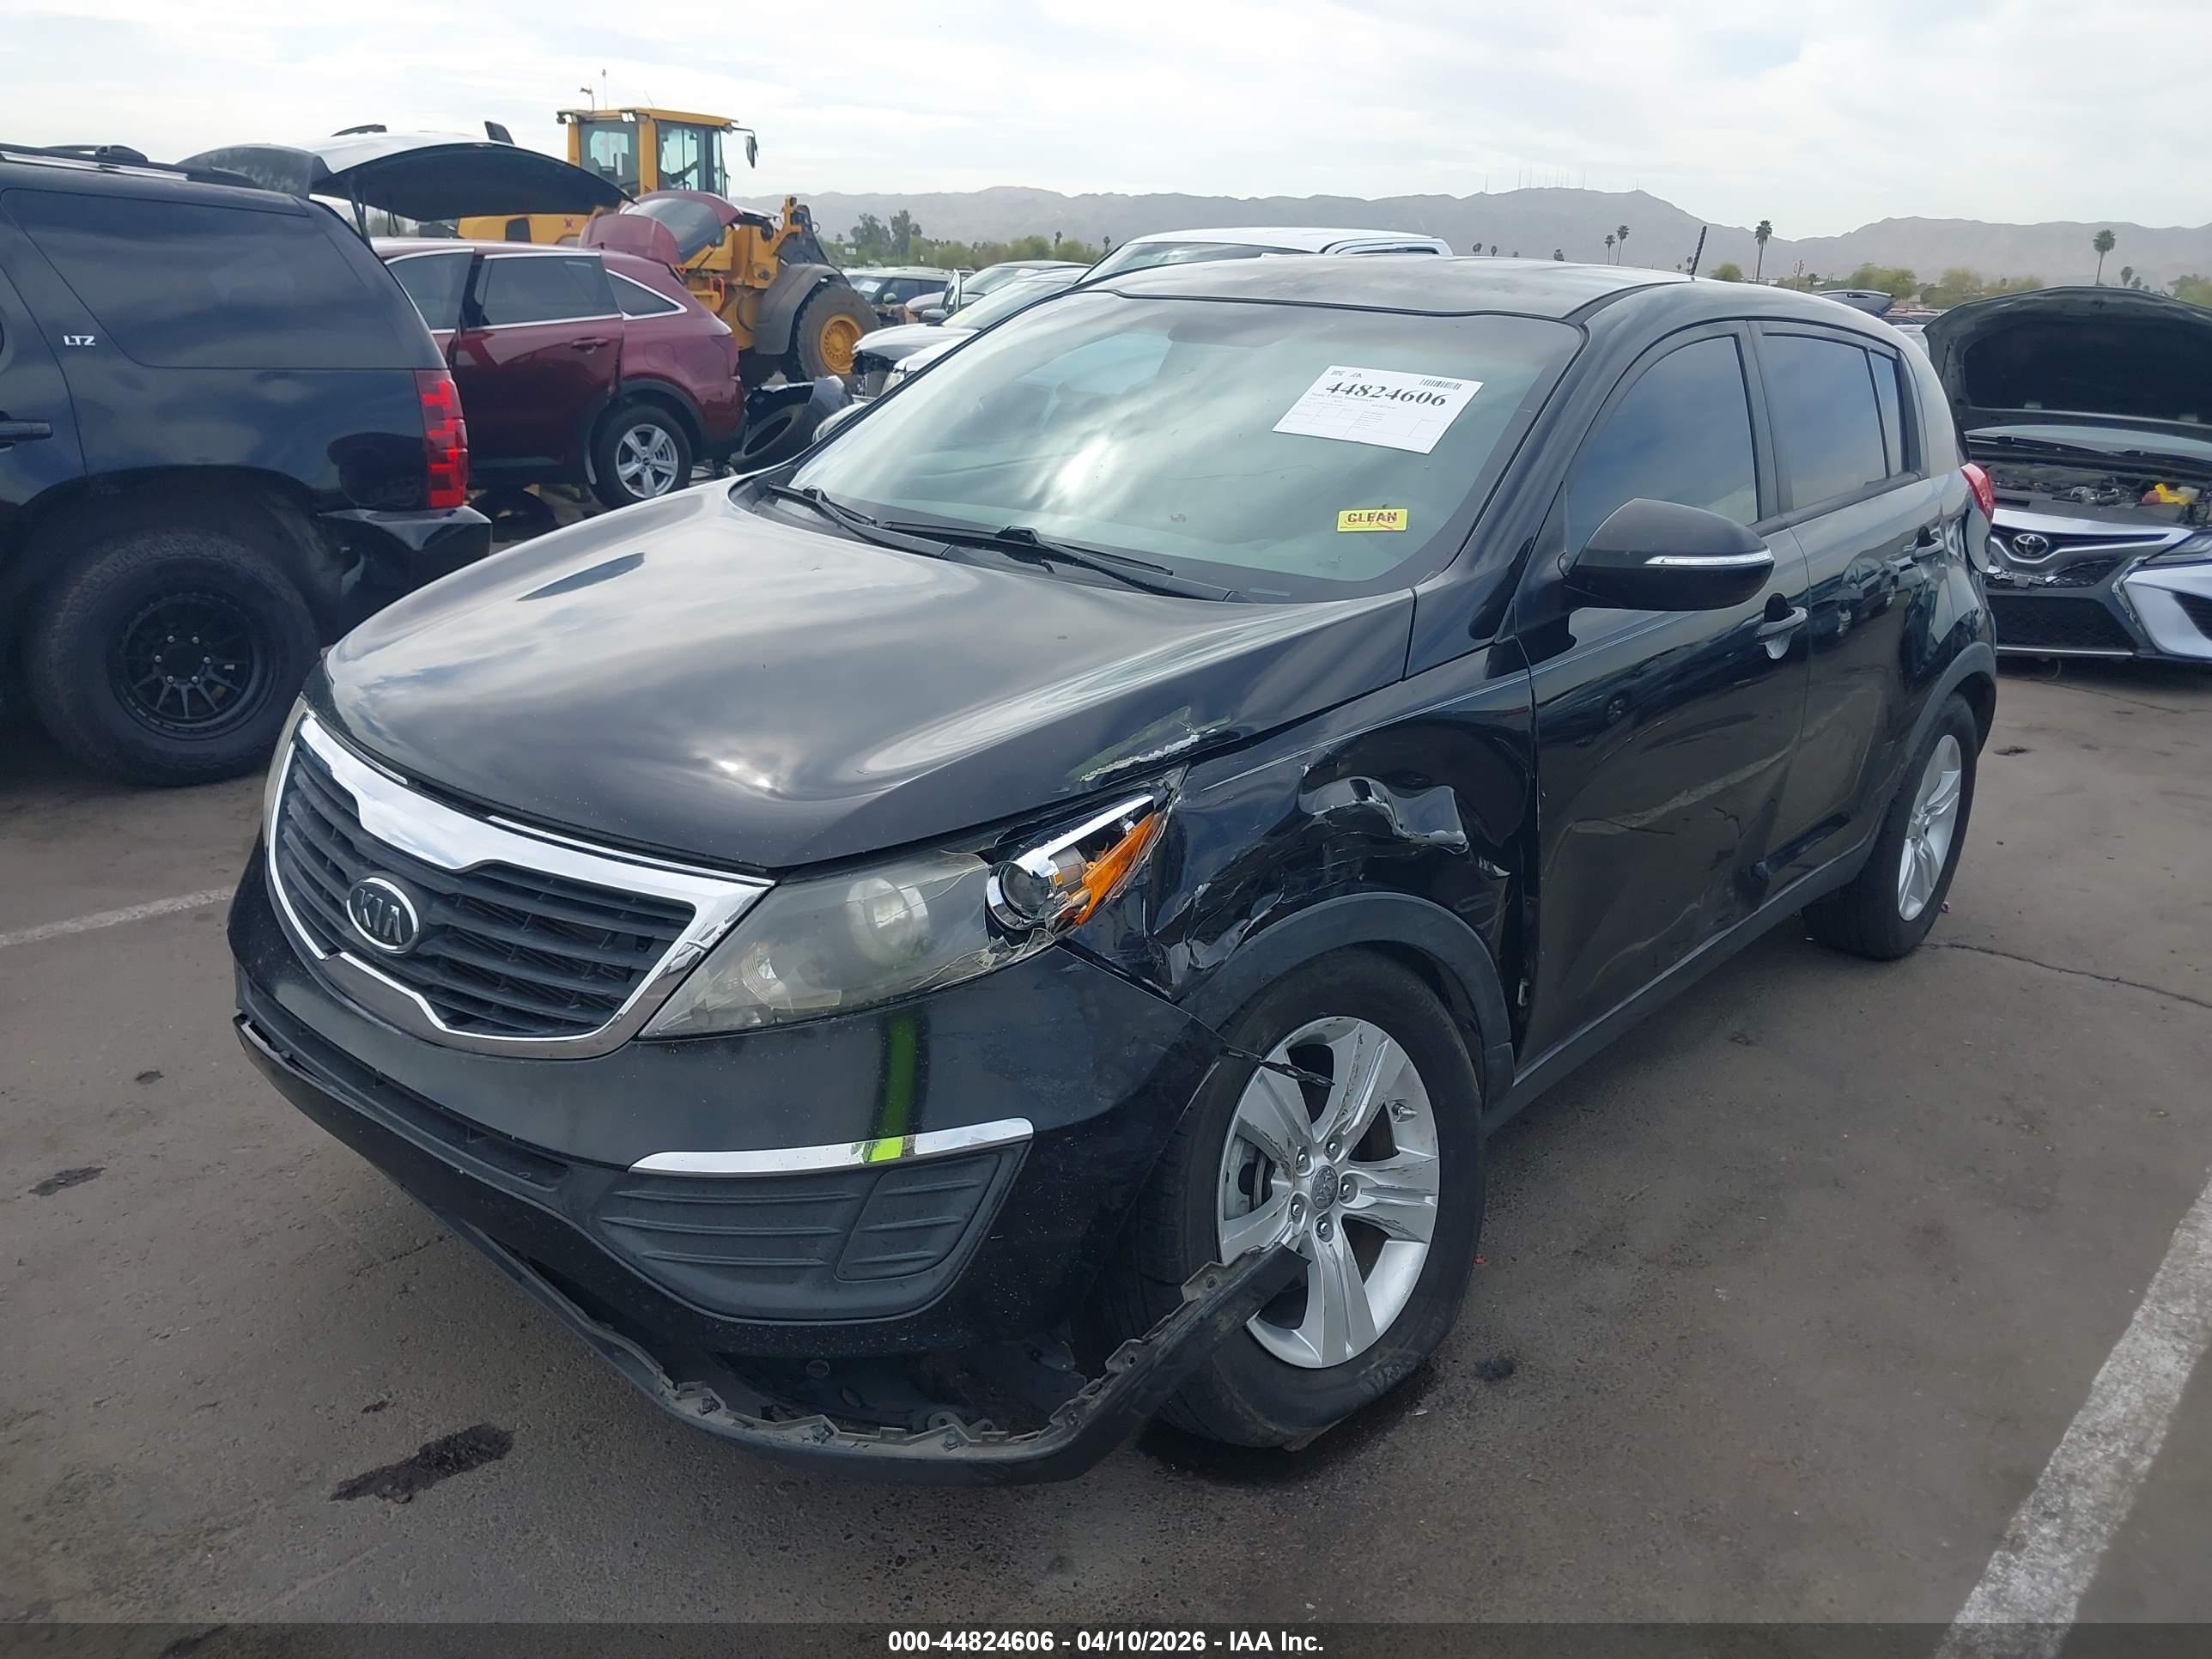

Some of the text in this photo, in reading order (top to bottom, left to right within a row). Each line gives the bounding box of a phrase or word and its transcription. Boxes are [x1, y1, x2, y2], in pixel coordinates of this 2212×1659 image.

[63, 335, 96, 346] LTZ
[1325, 381, 1450, 407] 44824606
[1347, 512, 1398, 523] CLEAN
